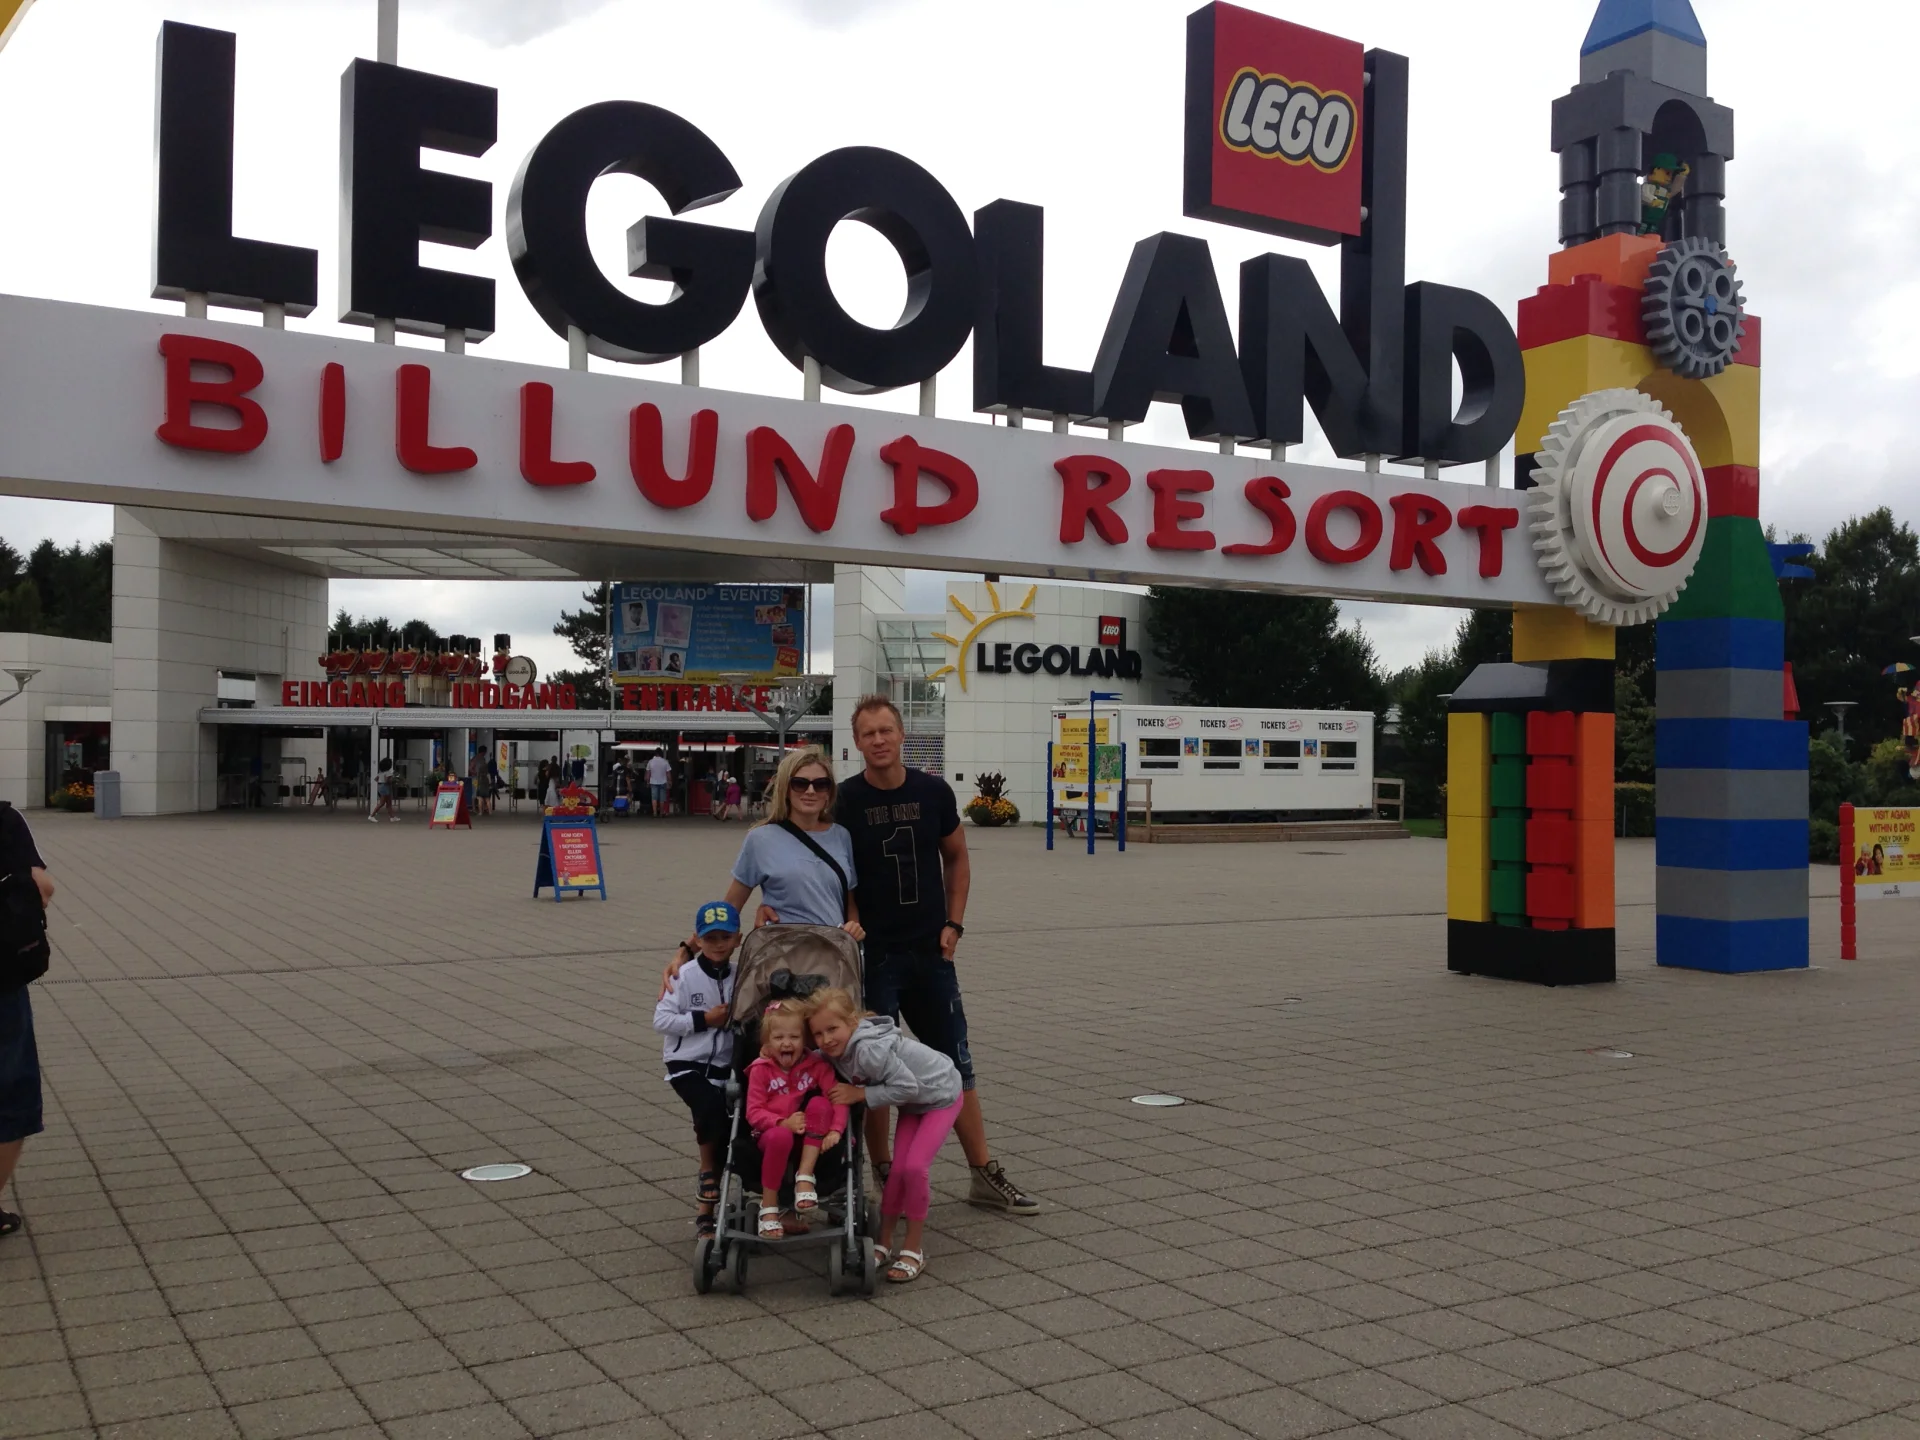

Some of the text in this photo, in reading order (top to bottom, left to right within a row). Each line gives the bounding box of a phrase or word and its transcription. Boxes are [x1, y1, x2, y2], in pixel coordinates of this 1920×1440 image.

[1222, 68, 1356, 171] LEGO
[150, 20, 1527, 467] LEGOLAND
[156, 333, 1520, 578] BILLUND RESORT
[719, 588, 780, 601] EVENTS
[1102, 625, 1120, 635] LEGO
[976, 643, 1142, 680] LEGOLAND
[282, 680, 406, 708] EINGANG
[453, 683, 576, 710] INDGANG
[623, 684, 771, 712] ENTRANCE
[1137, 718, 1164, 727] TICKETS
[1200, 719, 1226, 728] TICKETS
[1261, 721, 1286, 729] TICKETS
[1318, 722, 1343, 731] TICKETS
[865, 803, 921, 825] THE ONLY
[1873, 810, 1911, 820] VISIT AGAIN
[1869, 823, 1892, 833] WITHIN
[1899, 822, 1915, 832] DAYS
[882, 826, 919, 904] 1
